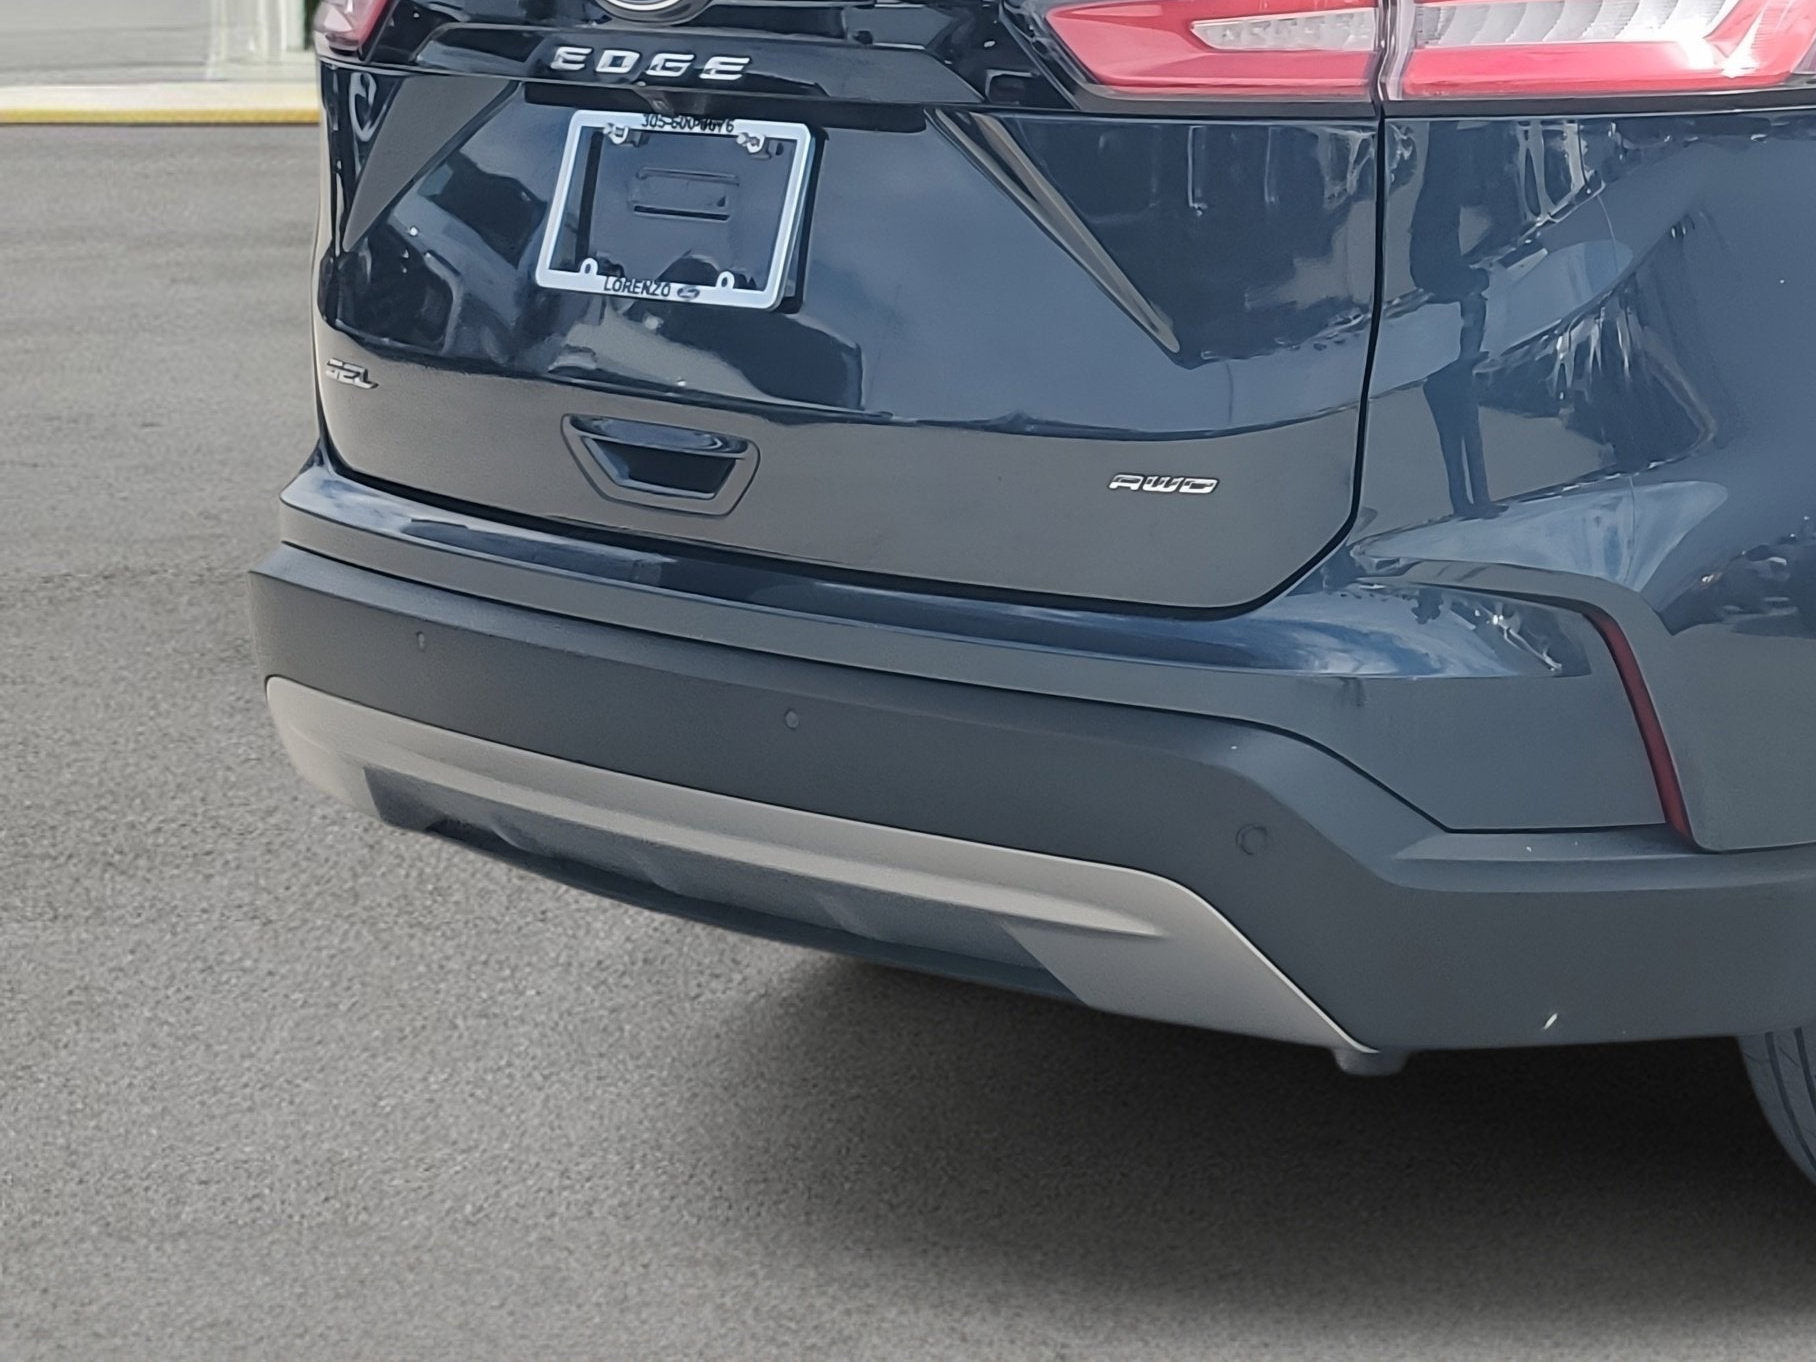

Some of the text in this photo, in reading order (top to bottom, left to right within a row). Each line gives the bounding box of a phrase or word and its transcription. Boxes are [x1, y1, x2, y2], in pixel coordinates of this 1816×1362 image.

[550, 45, 751, 81] EDGE
[603, 275, 672, 298] LORENZO
[1108, 473, 1220, 494] AWD
